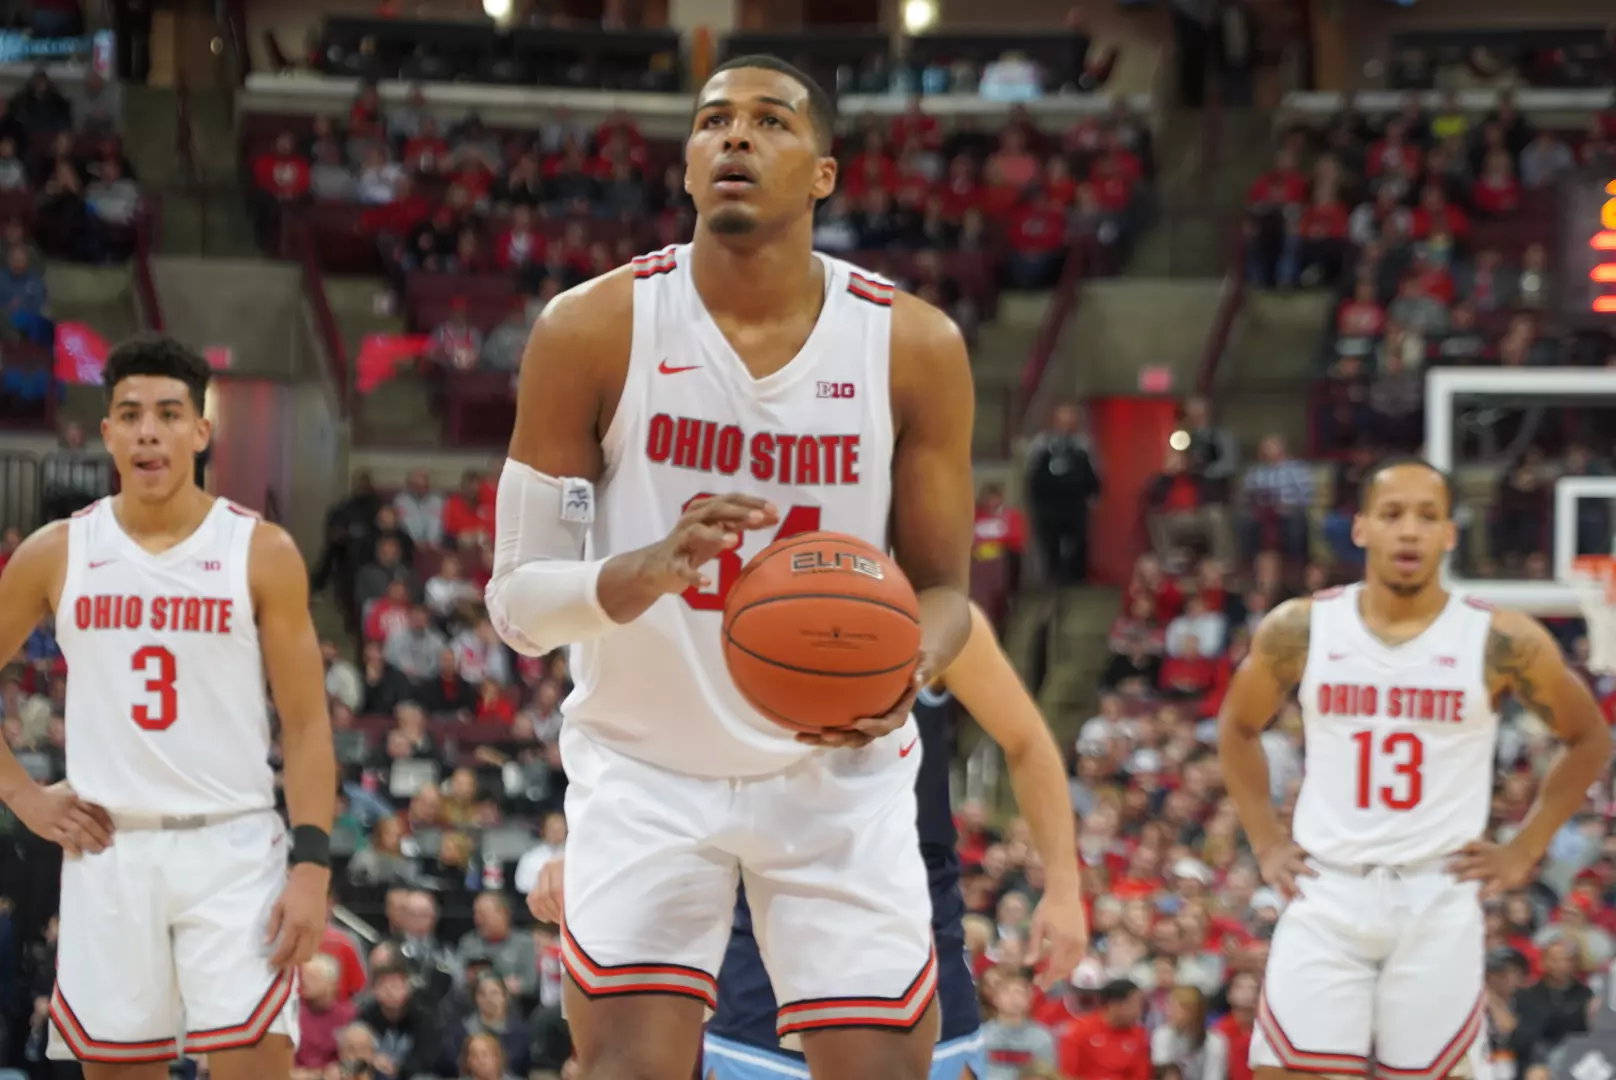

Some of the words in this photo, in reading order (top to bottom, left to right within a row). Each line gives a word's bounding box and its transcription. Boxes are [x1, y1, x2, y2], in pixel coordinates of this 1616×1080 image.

[646, 412, 745, 476] OHIO
[750, 431, 861, 485] STATE
[75, 594, 143, 630] OHIO
[150, 595, 233, 634] STATE
[131, 645, 177, 731] 3
[1318, 683, 1378, 716] OHIO
[1387, 686, 1465, 723] STATE
[1352, 730, 1424, 811] 13
